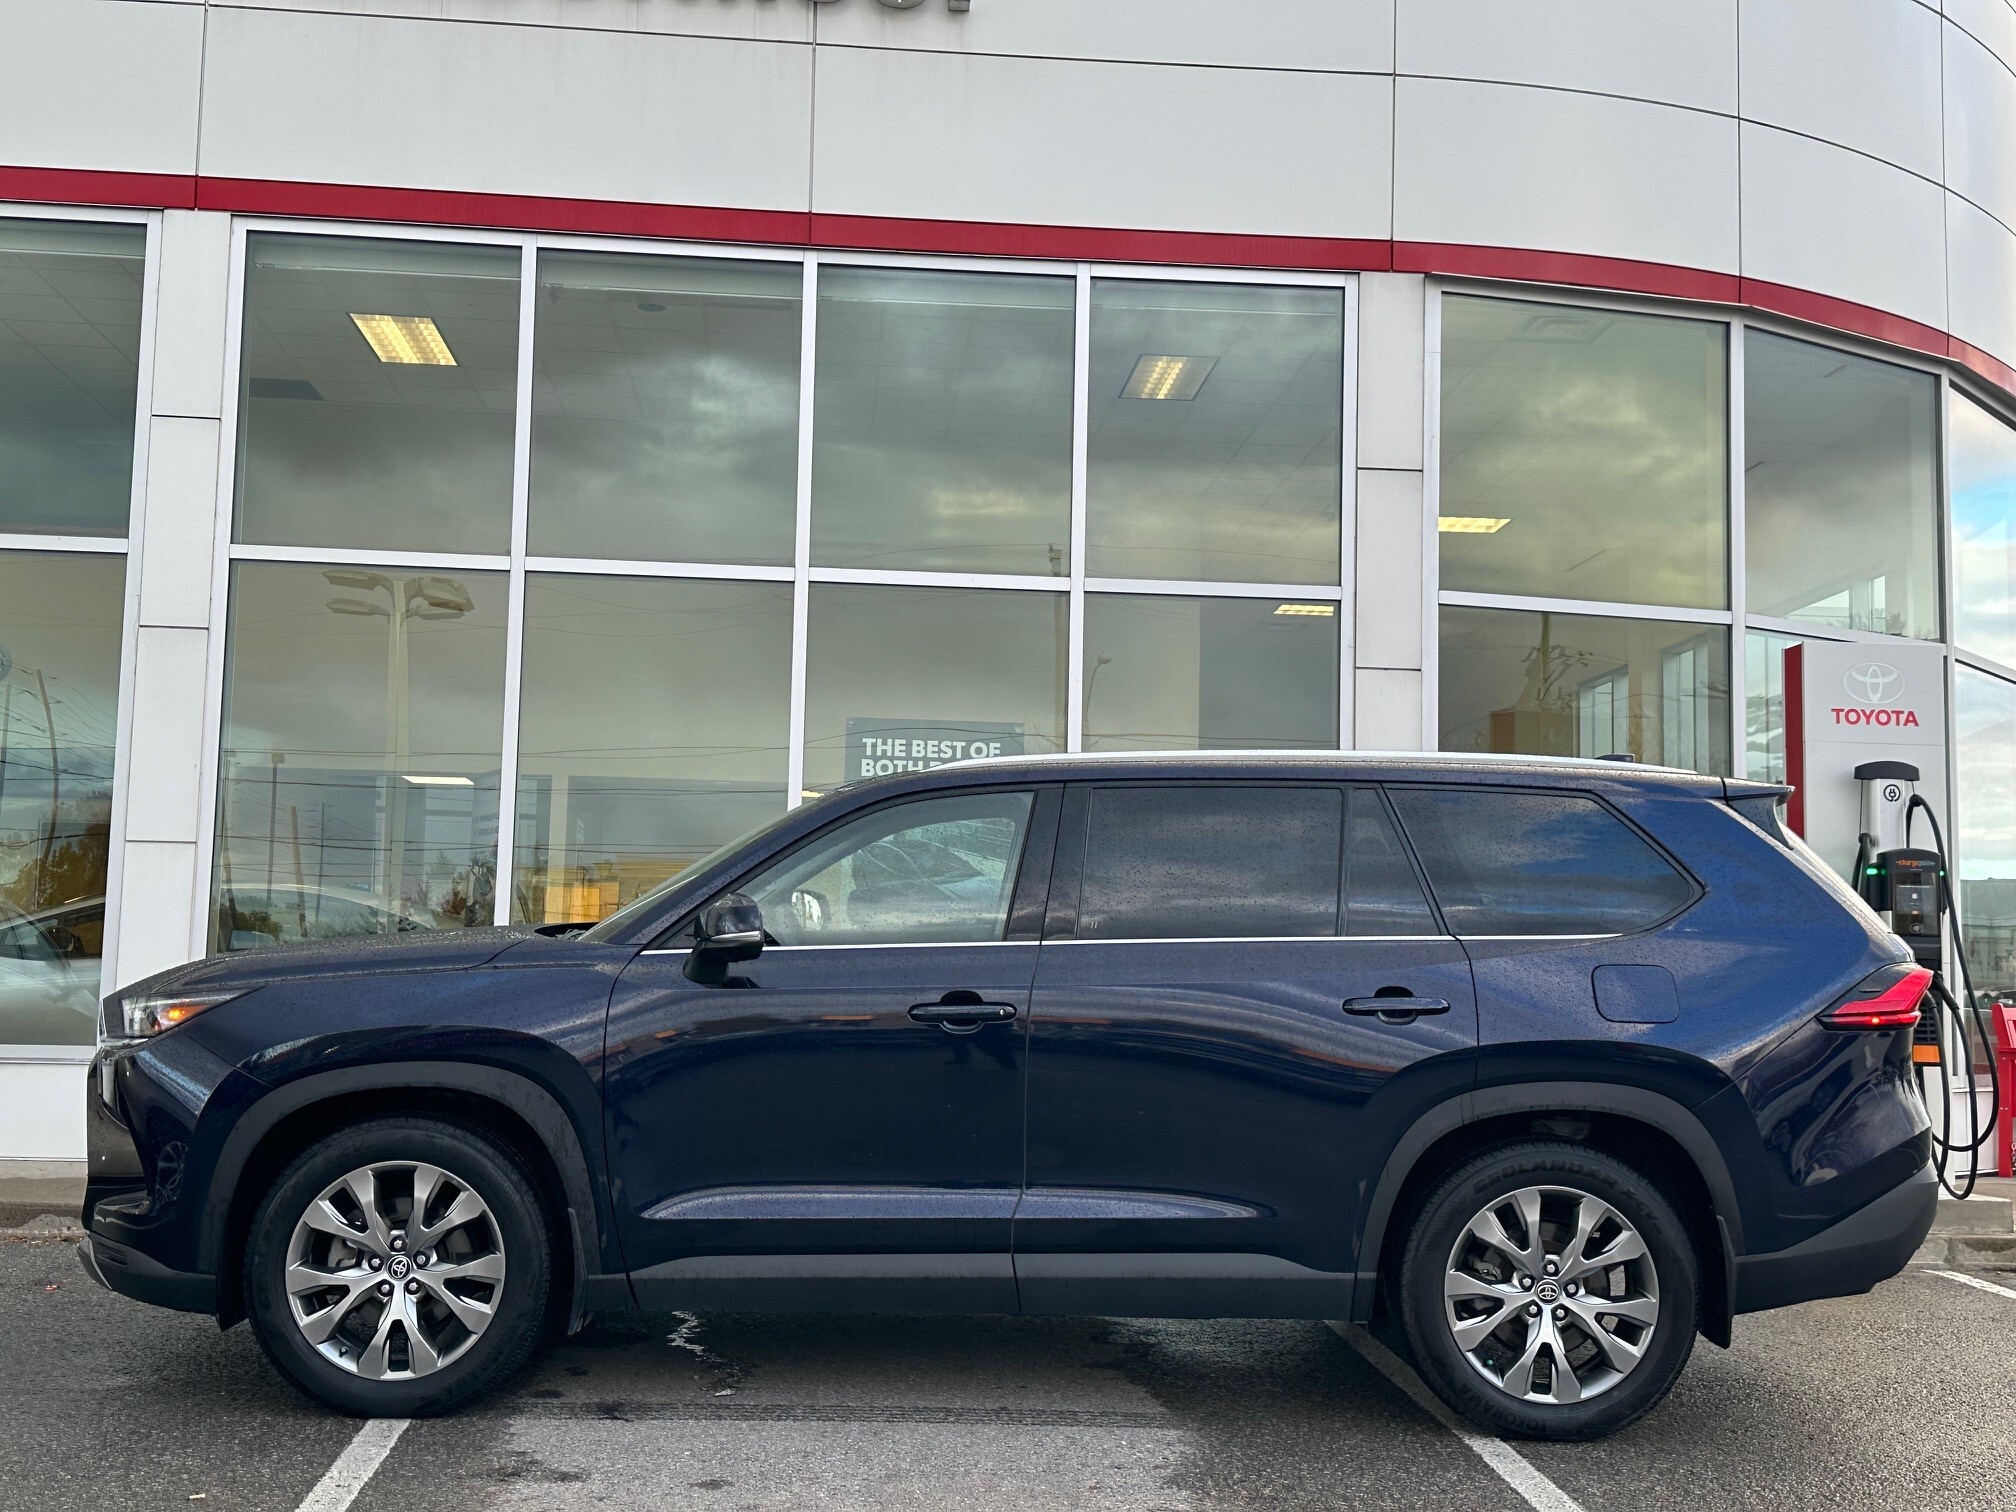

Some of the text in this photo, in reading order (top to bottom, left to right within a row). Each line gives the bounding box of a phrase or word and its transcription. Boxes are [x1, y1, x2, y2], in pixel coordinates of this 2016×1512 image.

[1831, 708, 1919, 727] TOYOTA
[862, 737, 1001, 759] THE BEST OF
